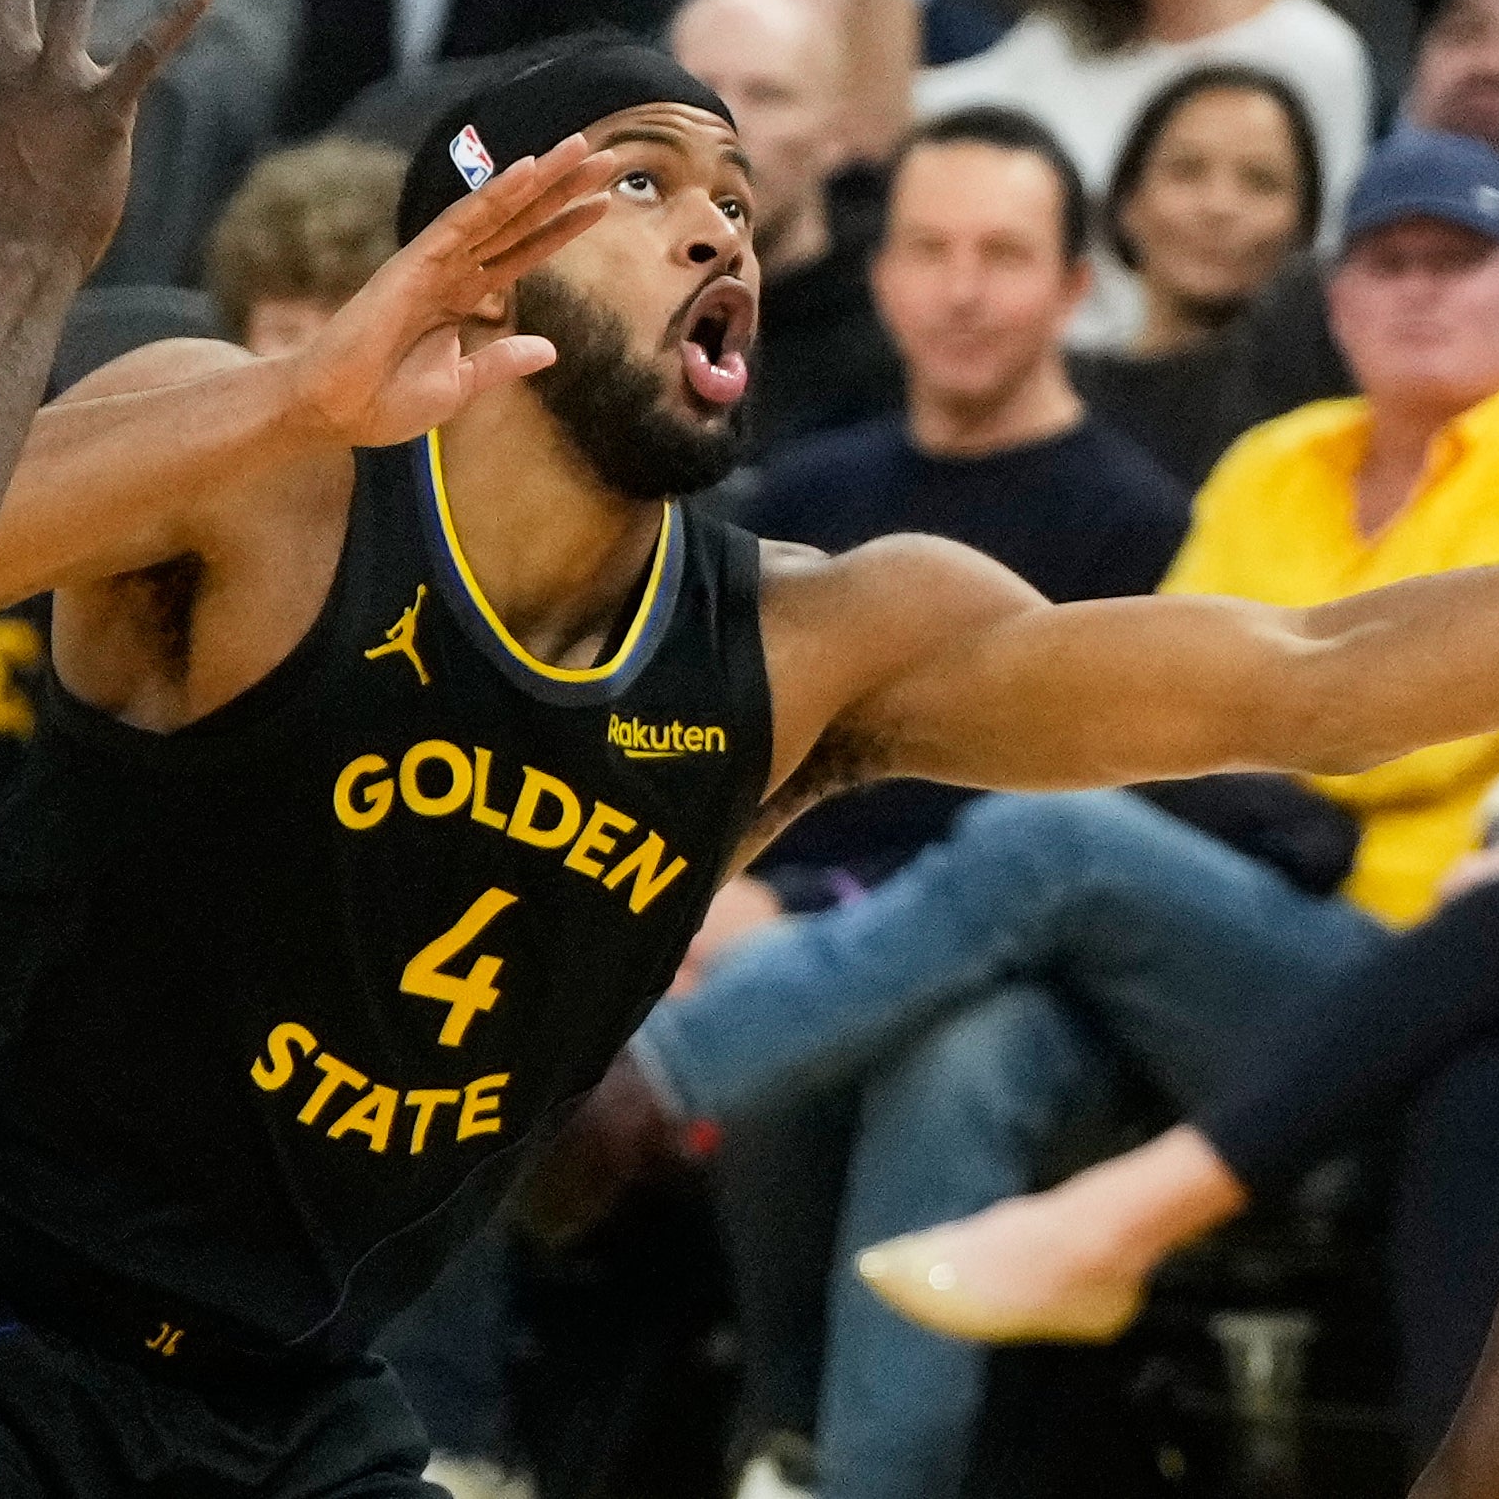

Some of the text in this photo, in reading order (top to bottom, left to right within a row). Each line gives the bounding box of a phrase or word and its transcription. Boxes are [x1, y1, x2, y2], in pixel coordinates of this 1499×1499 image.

[607, 713, 726, 753] Rakuten
[333, 739, 688, 915] GOLDEN
[399, 886, 519, 1048] 4
[250, 1021, 511, 1156] STATE
